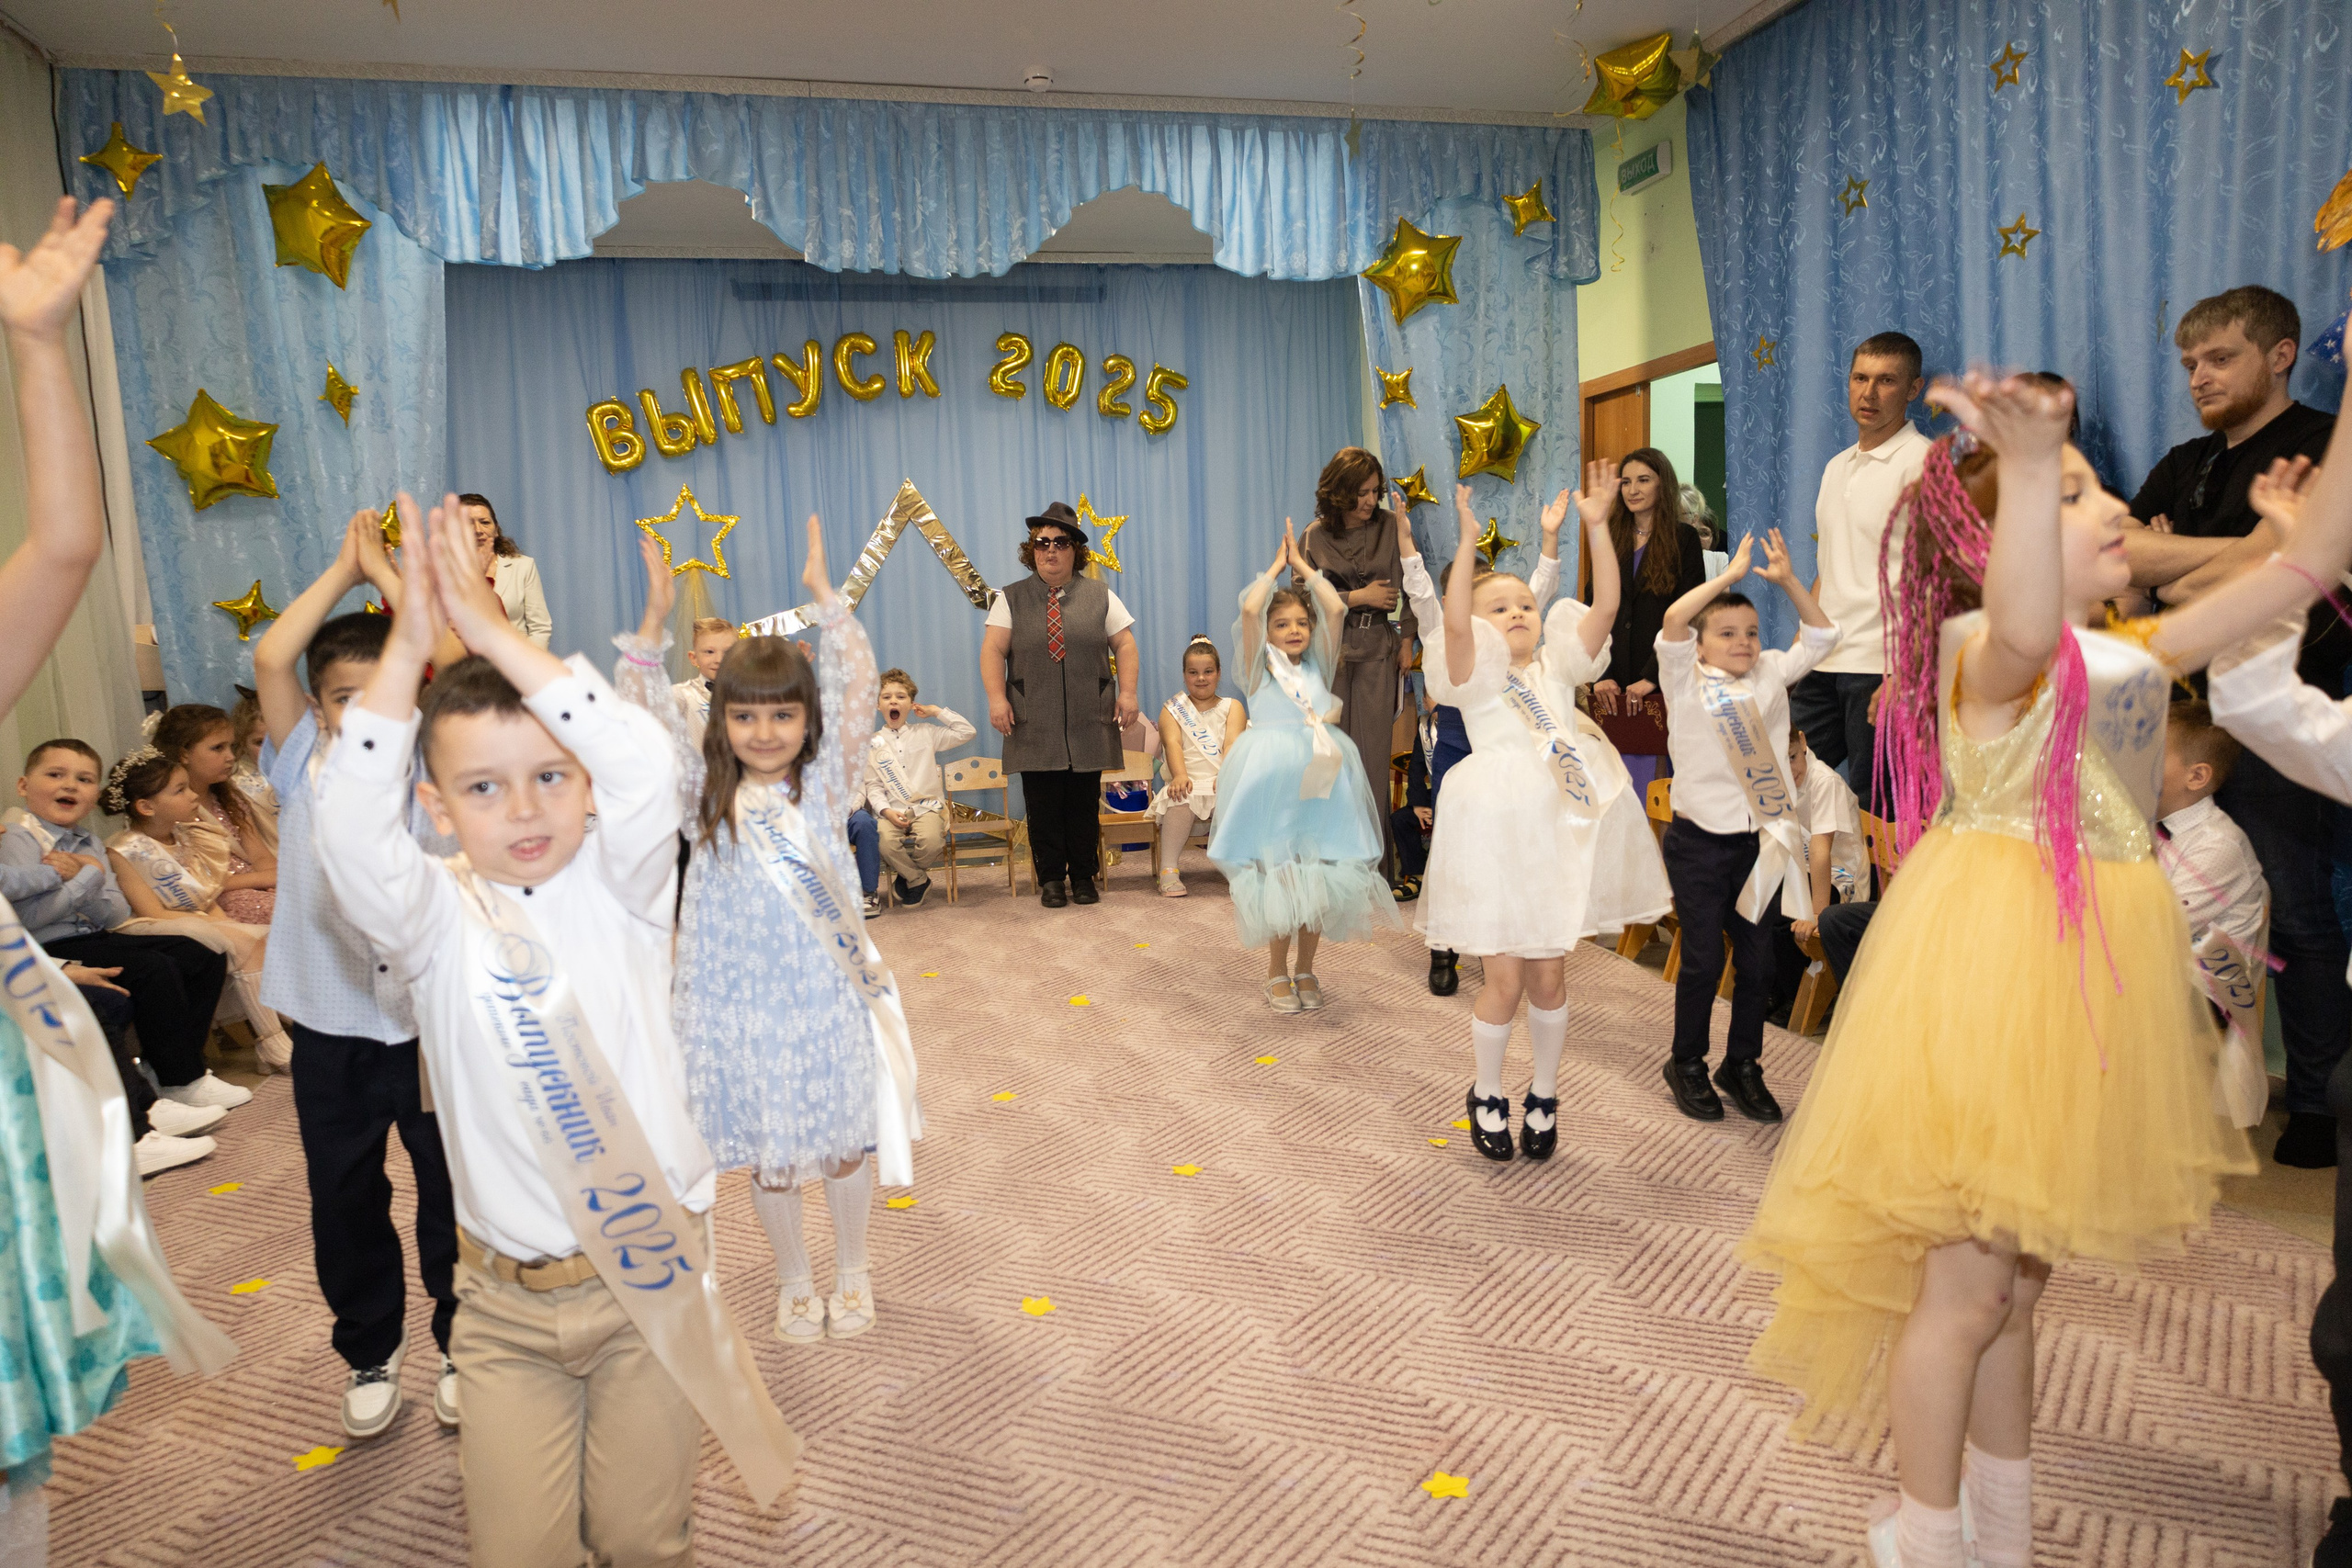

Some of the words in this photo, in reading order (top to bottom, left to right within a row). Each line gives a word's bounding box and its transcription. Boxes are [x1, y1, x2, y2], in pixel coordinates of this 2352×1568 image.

[1621, 153, 1656, 184] ВЫХОД
[585, 329, 941, 477] ВЫПУСК
[988, 331, 1190, 436] 2025
[876, 749, 912, 801] Выпускник
[1191, 728, 1222, 756] 2025
[1702, 672, 1757, 758] Выпускник
[1744, 762, 1792, 818] 2025
[831, 930, 894, 999] 2025
[481, 929, 606, 1164] Выпускник
[580, 1171, 695, 1292] 2025
